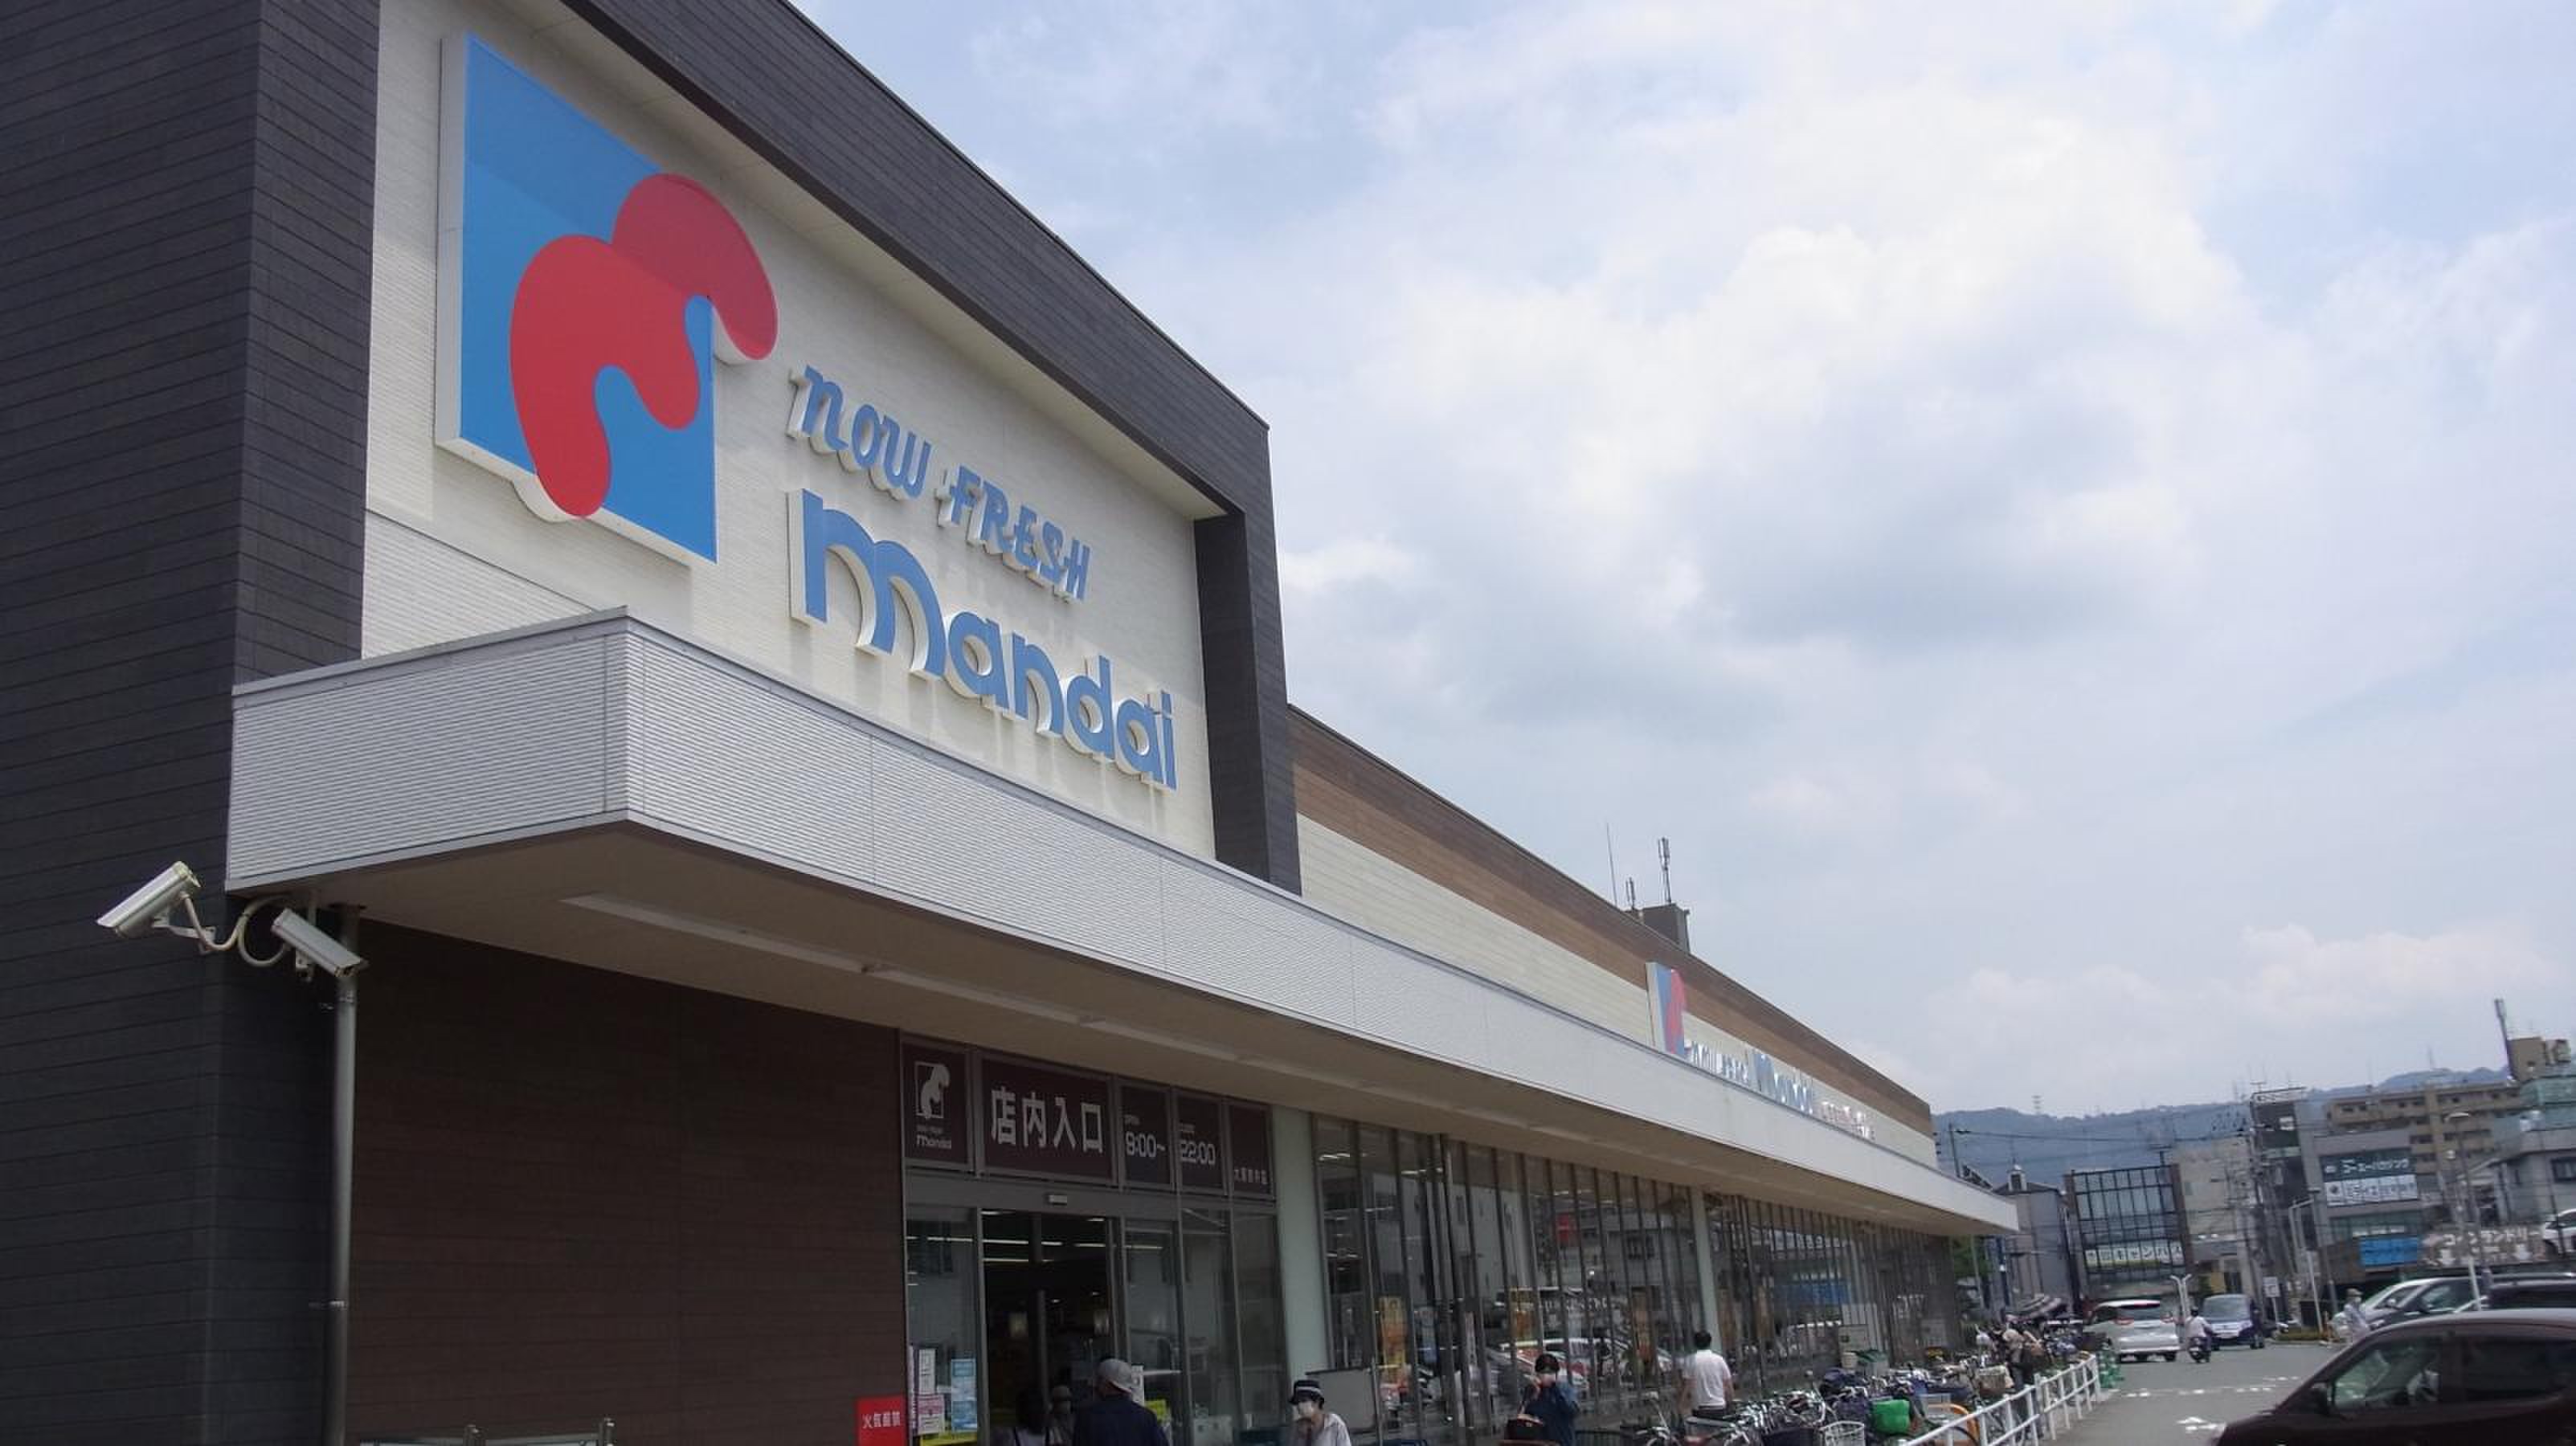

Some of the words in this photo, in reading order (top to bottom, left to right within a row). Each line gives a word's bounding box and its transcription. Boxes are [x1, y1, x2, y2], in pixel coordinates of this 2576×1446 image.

[936, 464, 1091, 604] FRESH
[787, 487, 1178, 791] mandai
[990, 1084, 1104, 1154] 店内入口
[1179, 1138, 1216, 1166] 22:00
